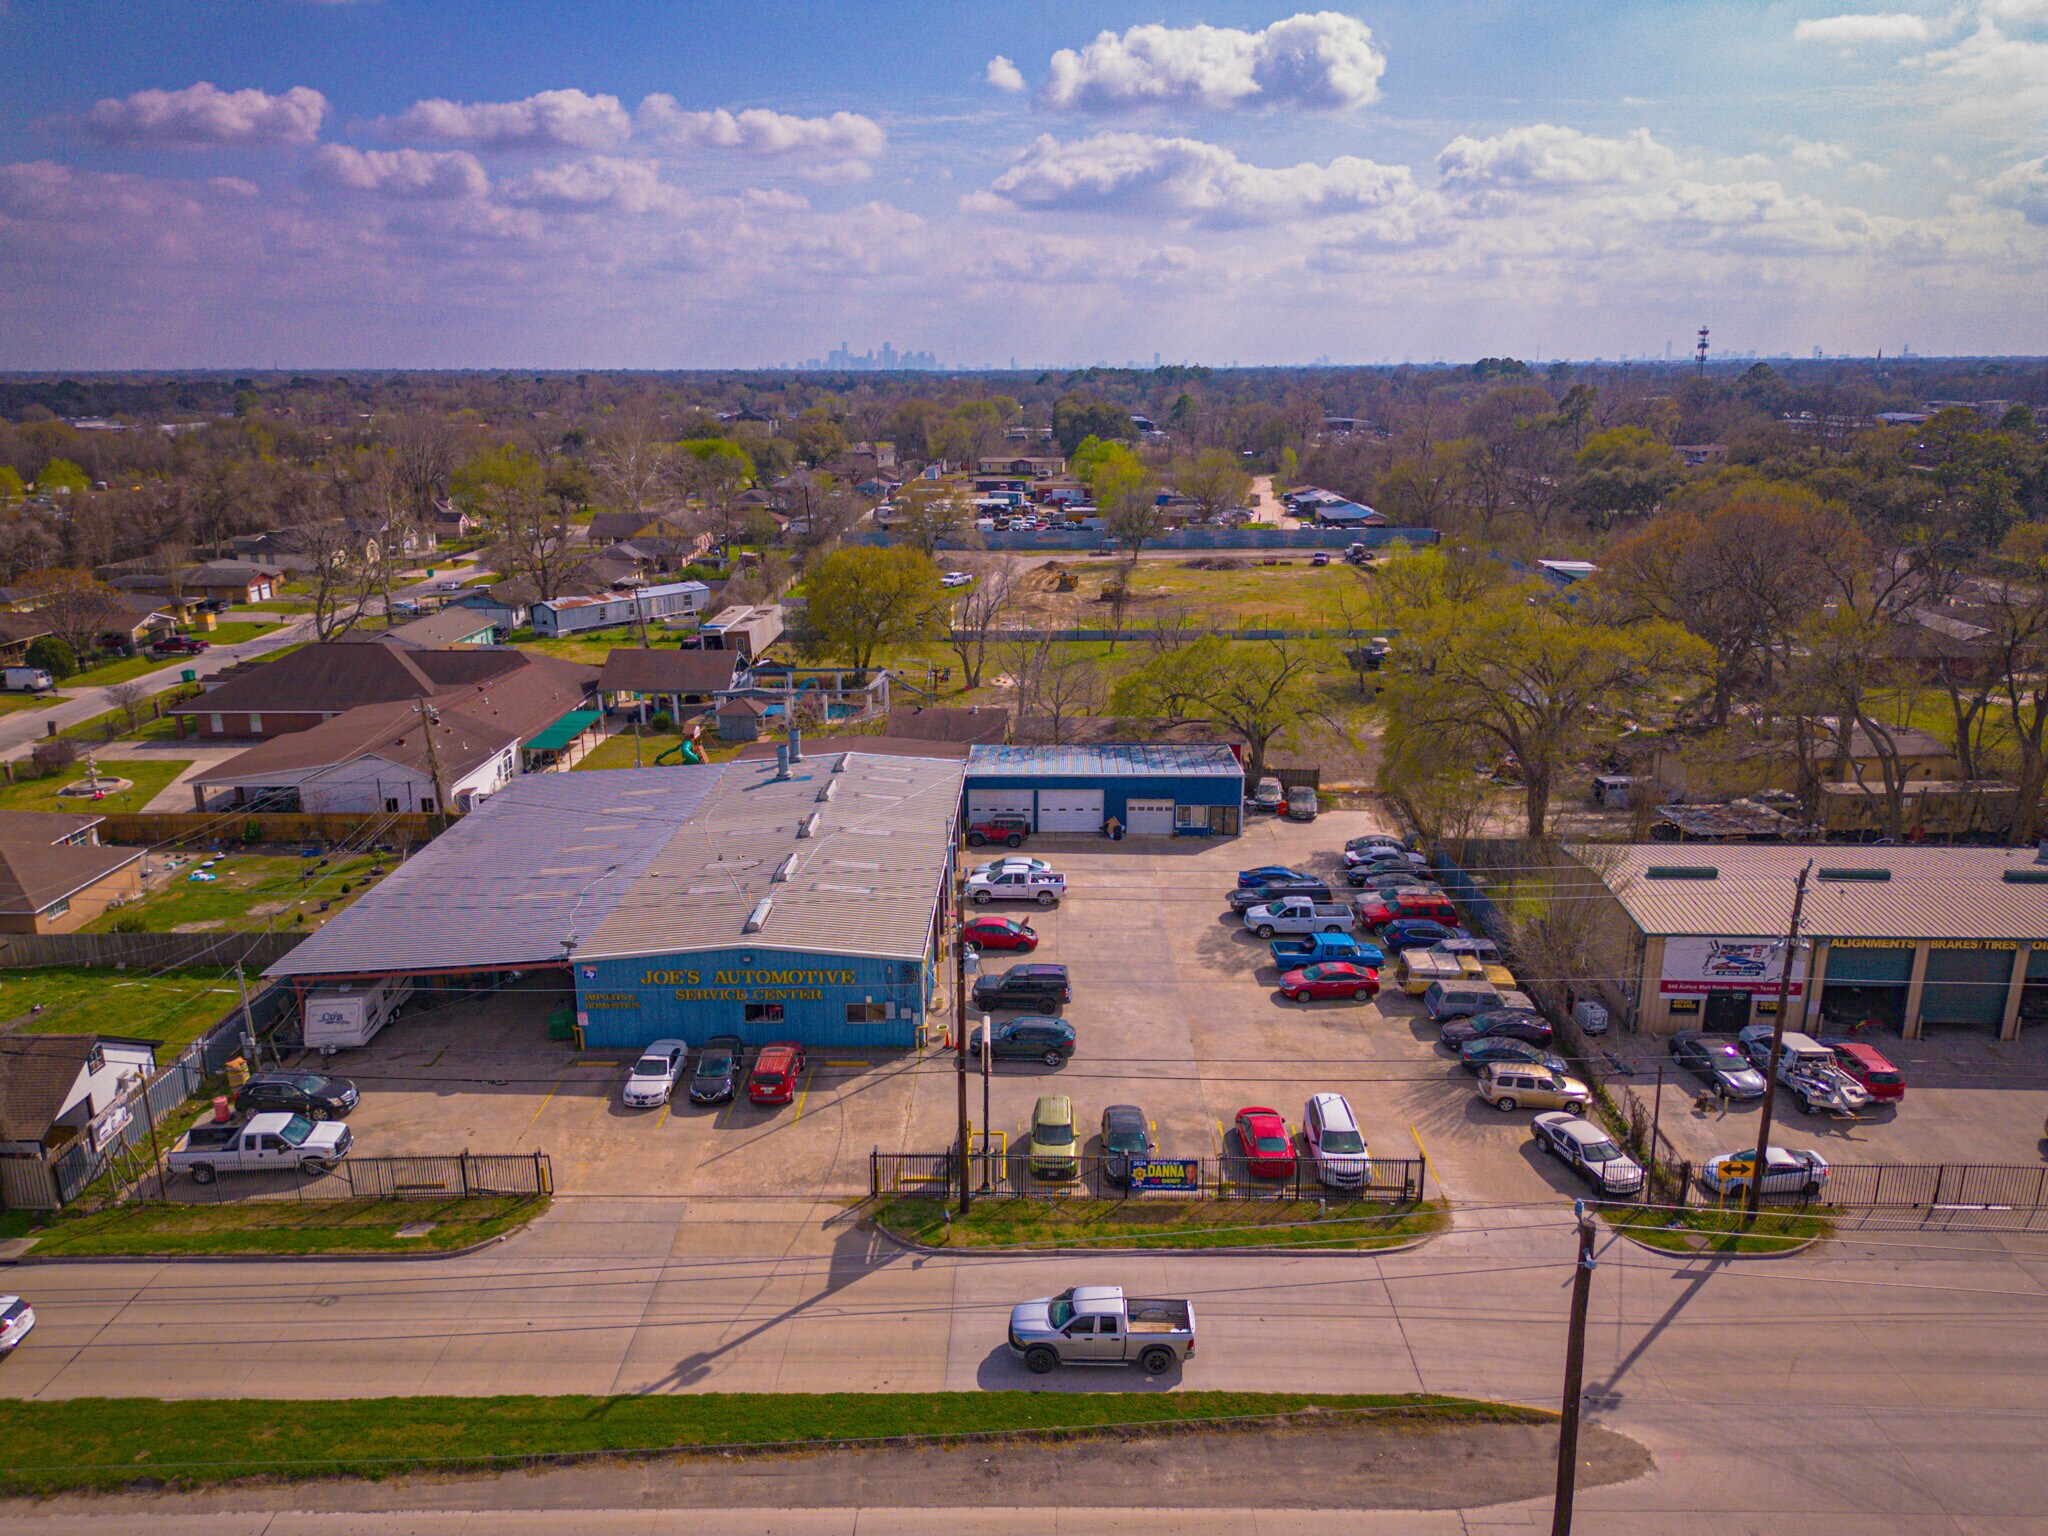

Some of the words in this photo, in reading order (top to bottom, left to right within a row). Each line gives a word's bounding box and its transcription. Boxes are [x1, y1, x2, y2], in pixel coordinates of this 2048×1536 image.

[1830, 938, 1917, 949] ALIGNMENTS
[641, 969, 700, 985] JOE'S
[714, 969, 856, 985] AUTOMOTIVE
[584, 993, 627, 1001] IMPORTS
[629, 993, 637, 1001] &
[675, 989, 748, 1001] SERVICE
[753, 989, 823, 1001] CENTER
[1147, 1164, 1185, 1178] DANNA
